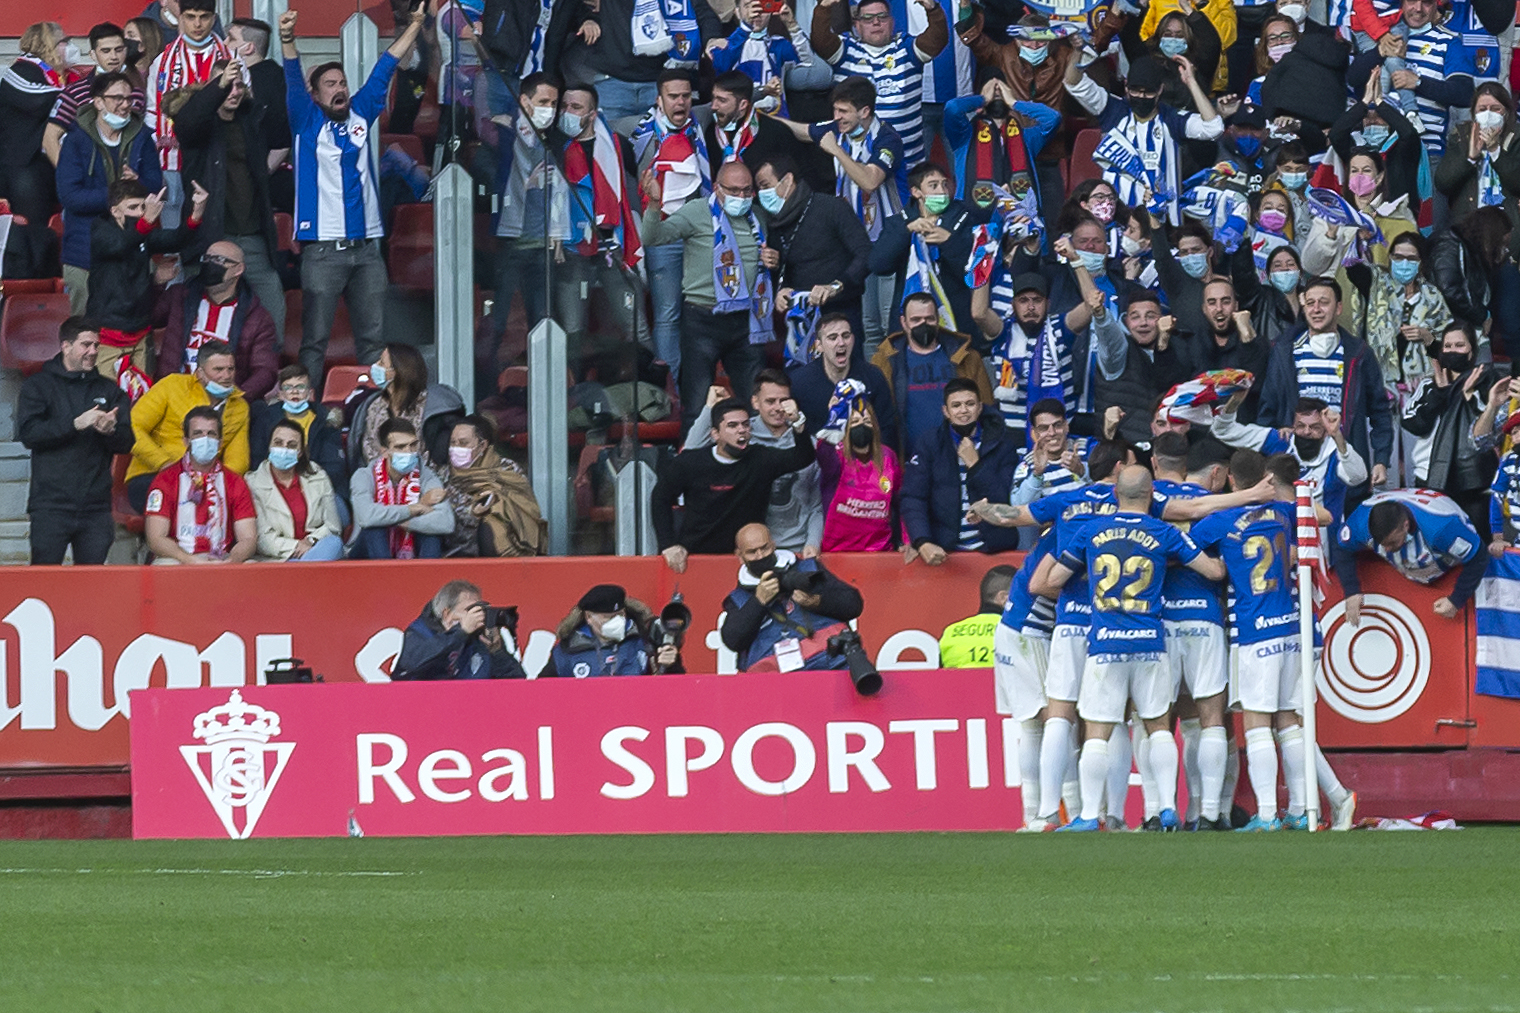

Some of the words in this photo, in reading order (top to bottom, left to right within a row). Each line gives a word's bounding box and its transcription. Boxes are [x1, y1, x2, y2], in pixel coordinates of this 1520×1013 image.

[1092, 528, 1126, 548] PARIS
[1126, 529, 1160, 551] ADOT
[1092, 553, 1155, 613] 22
[952, 622, 995, 638] SEGUR
[357, 726, 555, 804] Real
[600, 718, 1022, 801] SPORTI
